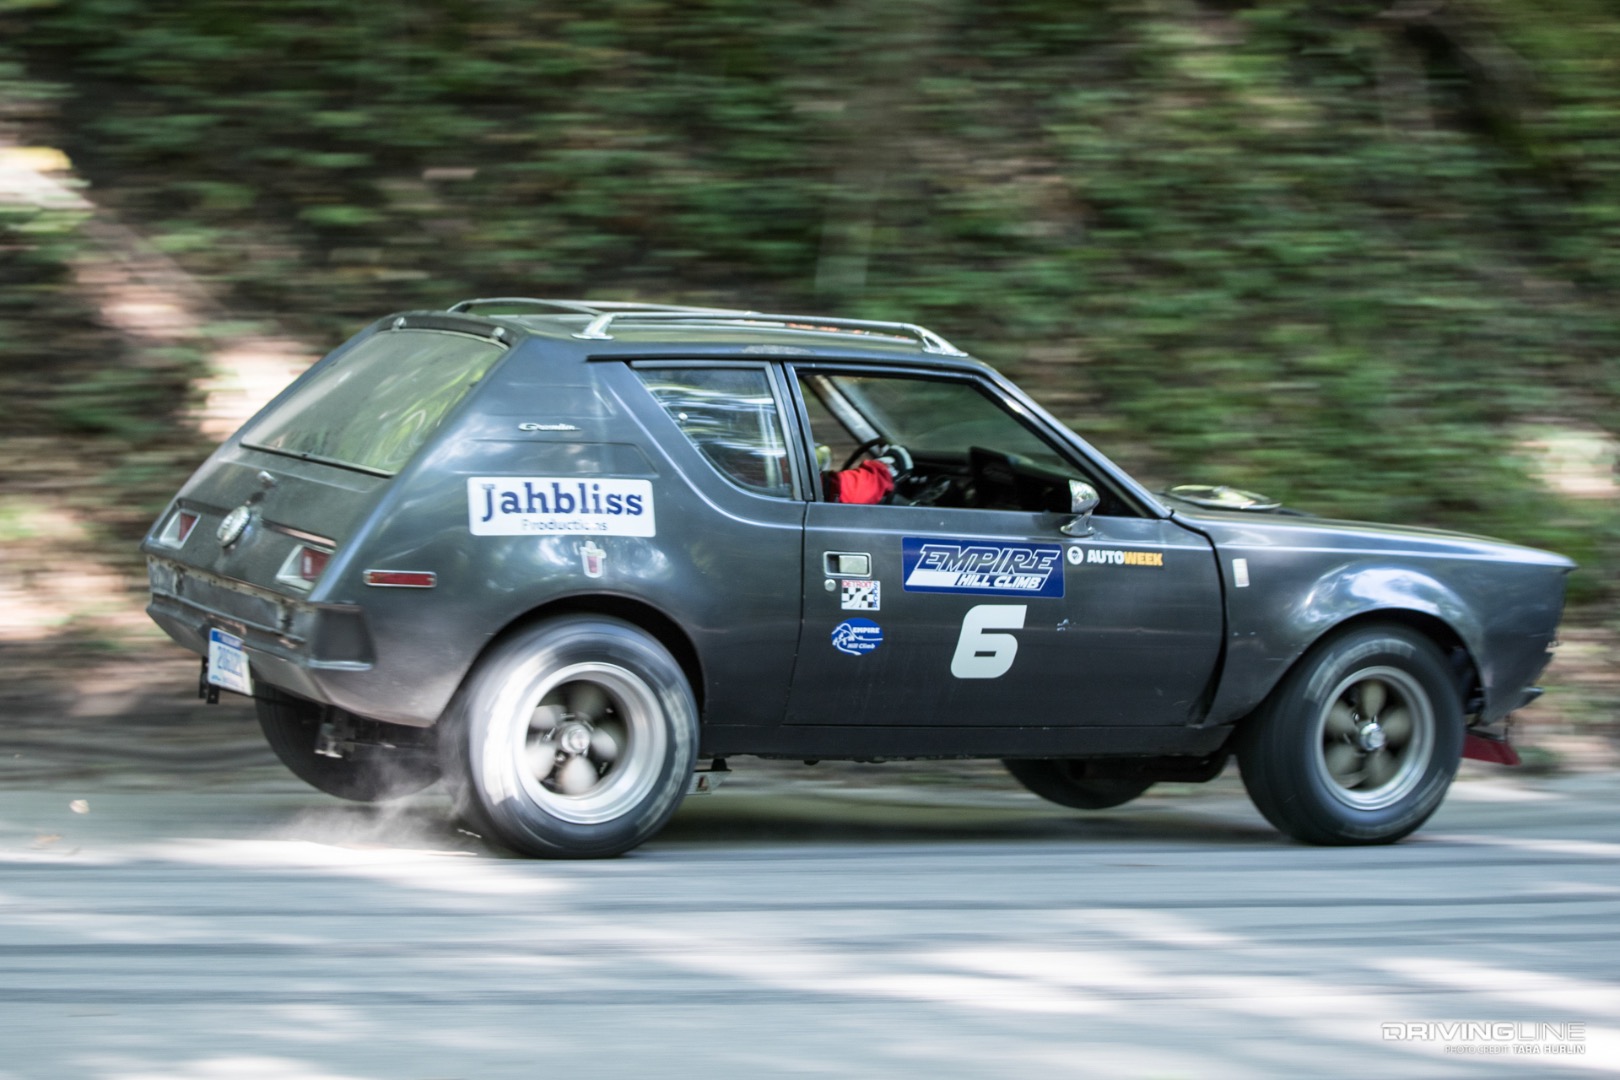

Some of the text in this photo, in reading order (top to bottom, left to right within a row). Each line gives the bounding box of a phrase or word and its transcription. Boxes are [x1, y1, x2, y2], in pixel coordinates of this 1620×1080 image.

[480, 482, 643, 522] Jahbliss
[915, 544, 1061, 574] EMPIRE
[1087, 549, 1163, 566] AUTOWEEK
[957, 573, 1036, 589] HILL CLIMB
[951, 604, 1028, 679] 6
